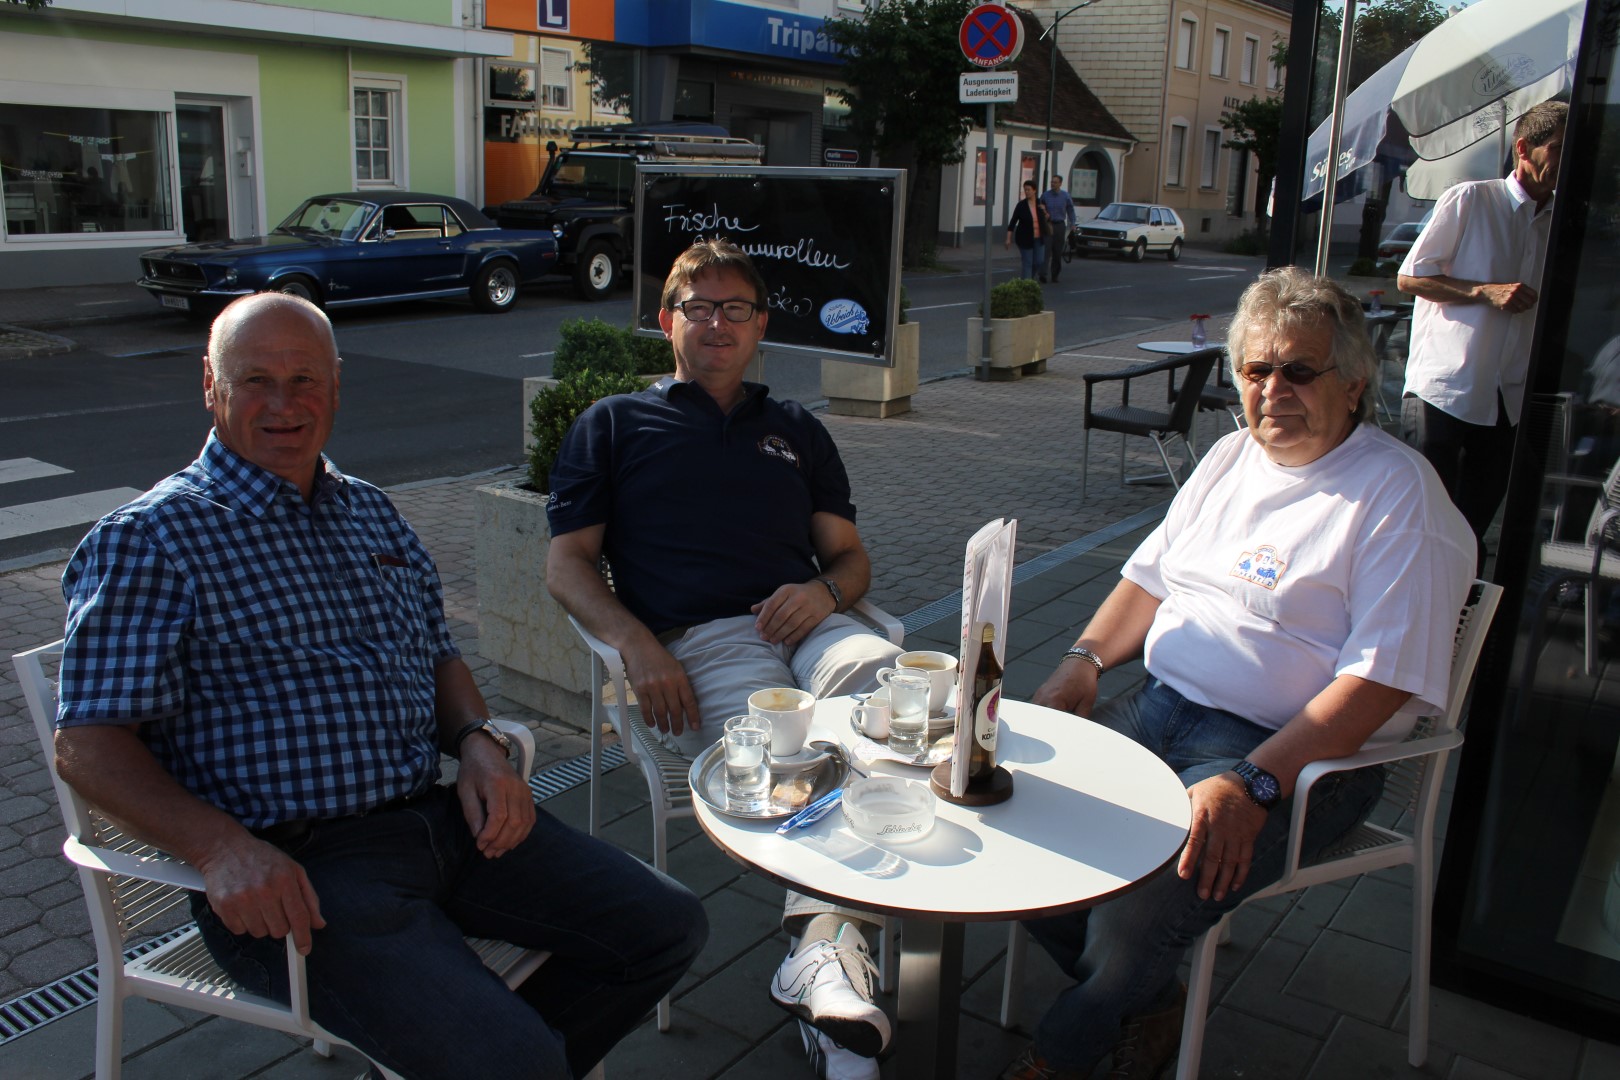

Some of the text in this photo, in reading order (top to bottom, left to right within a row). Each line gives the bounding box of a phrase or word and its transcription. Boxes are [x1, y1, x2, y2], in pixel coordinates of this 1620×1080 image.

[546, 0, 563, 24] L
[972, 54, 1004, 67] ANFANG
[963, 78, 1015, 87] Ausgenommen
[966, 88, 1012, 97] Ladetätigkeit
[662, 202, 760, 233] Frische
